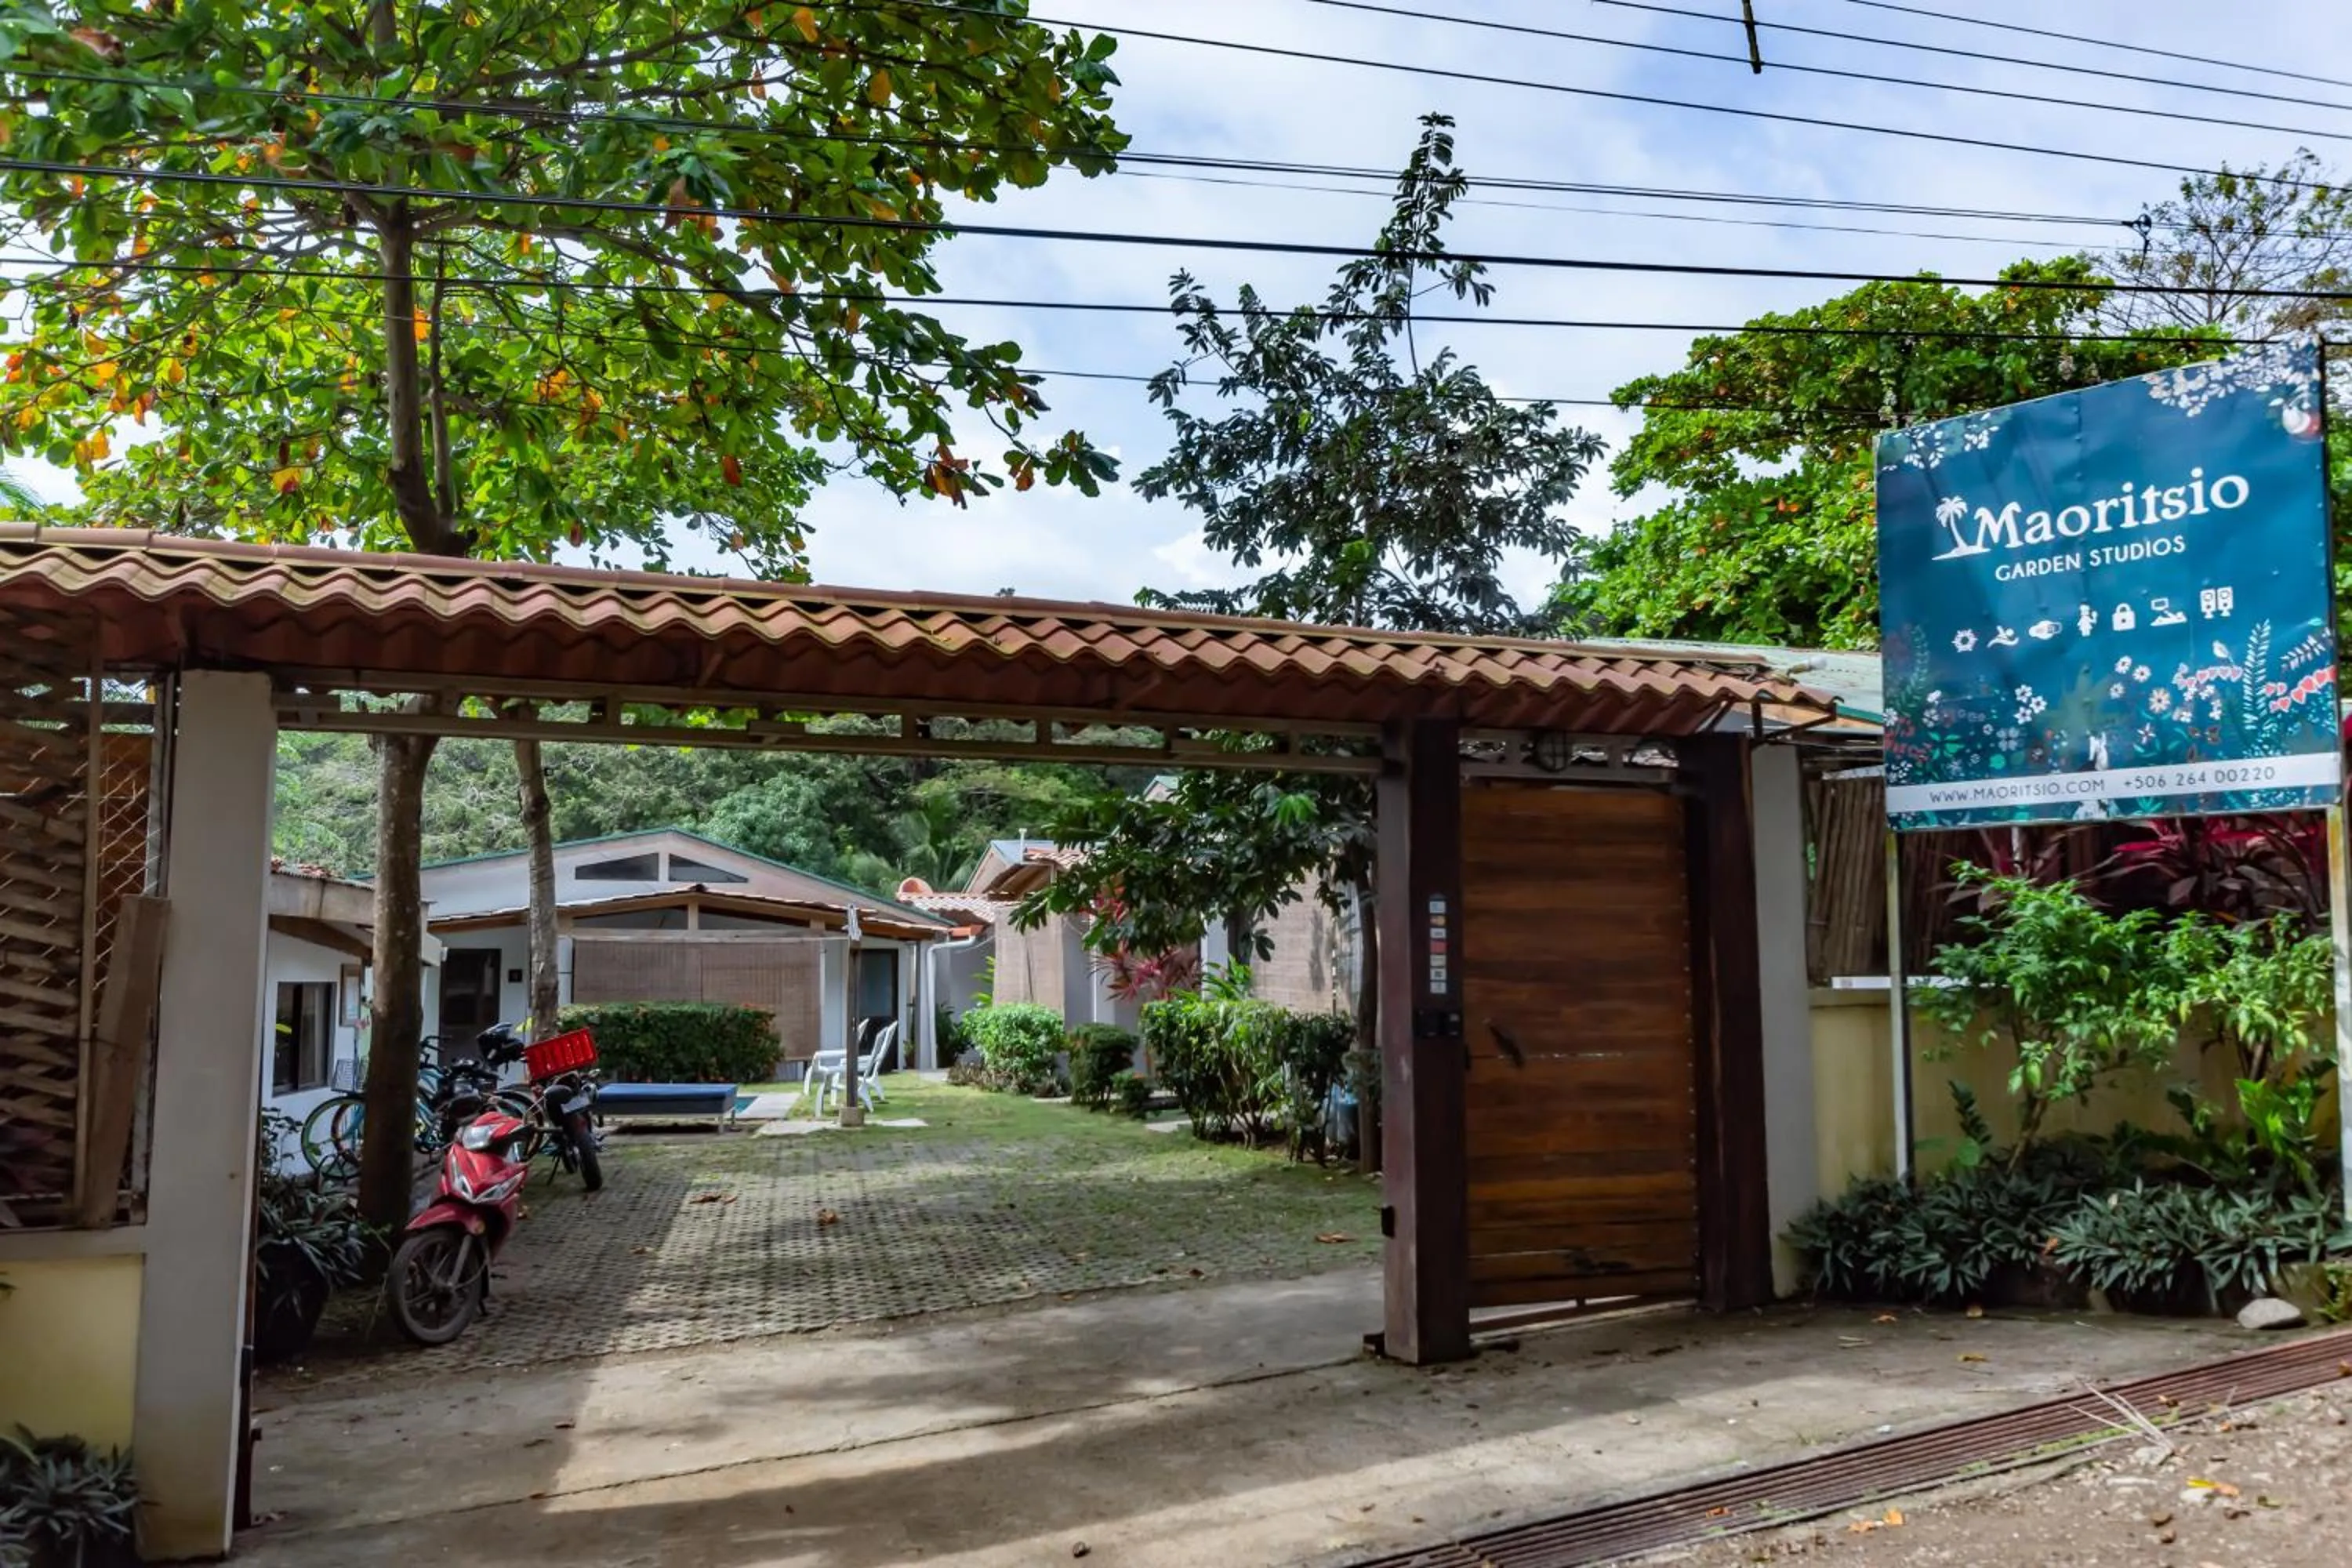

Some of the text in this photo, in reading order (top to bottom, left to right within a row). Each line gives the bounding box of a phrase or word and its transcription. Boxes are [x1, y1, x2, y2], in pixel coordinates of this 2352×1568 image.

[1973, 467, 2249, 550] Maoritsio
[1994, 535, 2186, 581] GARDEN STUDIOS
[1929, 766, 2276, 804] WWW.MAORITSIO.COM +506 264 00220
